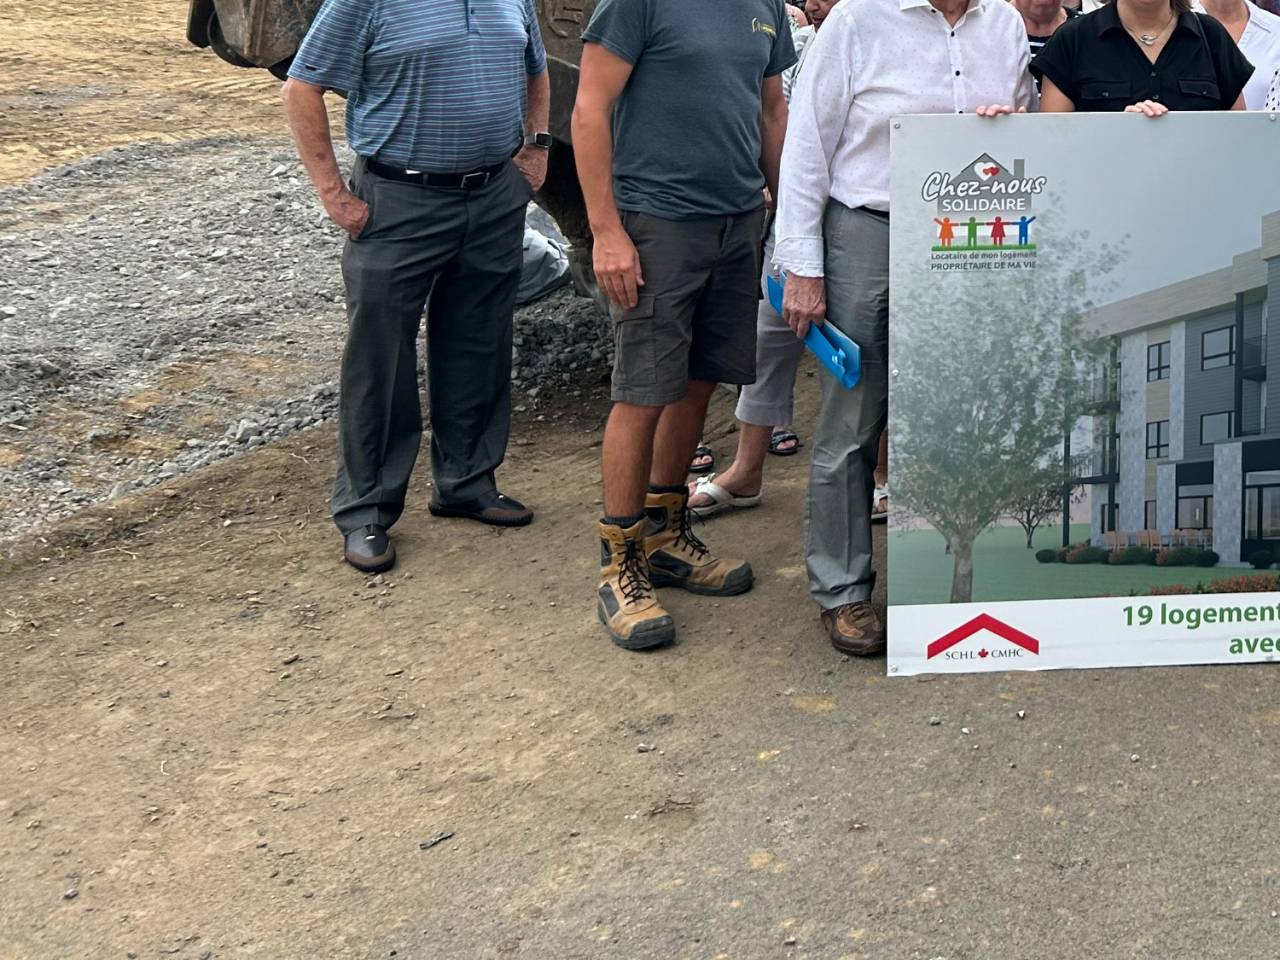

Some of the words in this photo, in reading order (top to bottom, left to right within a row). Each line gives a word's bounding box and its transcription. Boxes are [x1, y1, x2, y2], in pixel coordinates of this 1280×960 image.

[922, 171, 1047, 202] Chez-nous
[942, 198, 1026, 212] SOLIDAIRE
[930, 252, 968, 260] Locataire
[969, 251, 980, 259] de
[1000, 251, 1037, 260] logement
[931, 261, 993, 271] PROPRIÉTAIRE
[993, 262, 1006, 270] DE
[1007, 261, 1022, 270] MA
[1023, 260, 1037, 269] VIE
[1123, 604, 1153, 626] 19
[945, 650, 976, 661] SCHL
[990, 648, 1024, 660] CMHC
